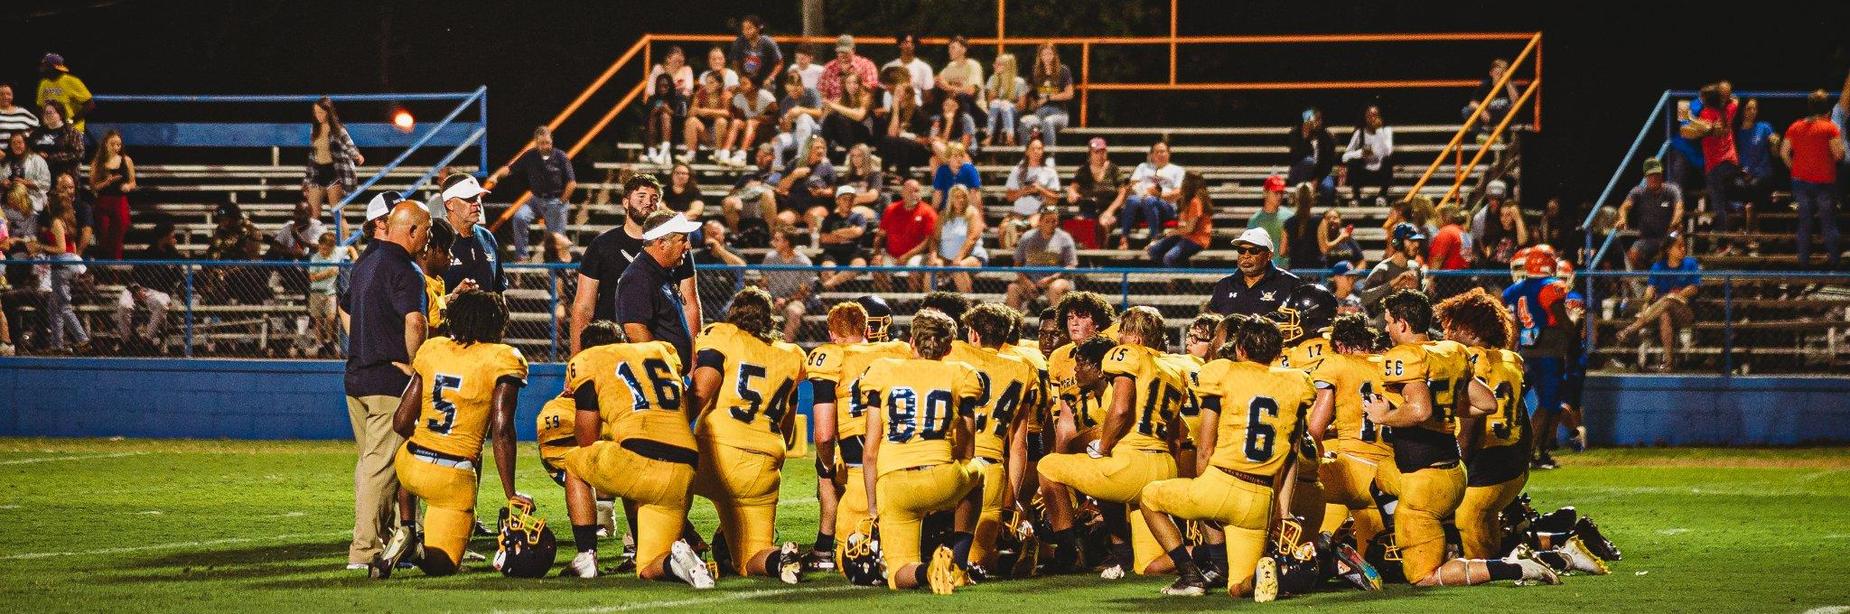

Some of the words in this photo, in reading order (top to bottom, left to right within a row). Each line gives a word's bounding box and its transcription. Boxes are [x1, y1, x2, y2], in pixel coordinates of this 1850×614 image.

[1110, 347, 1129, 362] 15
[1307, 343, 1323, 358] 17
[426, 372, 463, 437] 5
[615, 357, 685, 411] 16
[728, 360, 796, 435] 54
[887, 385, 954, 444] 80
[1242, 395, 1280, 464] 6
